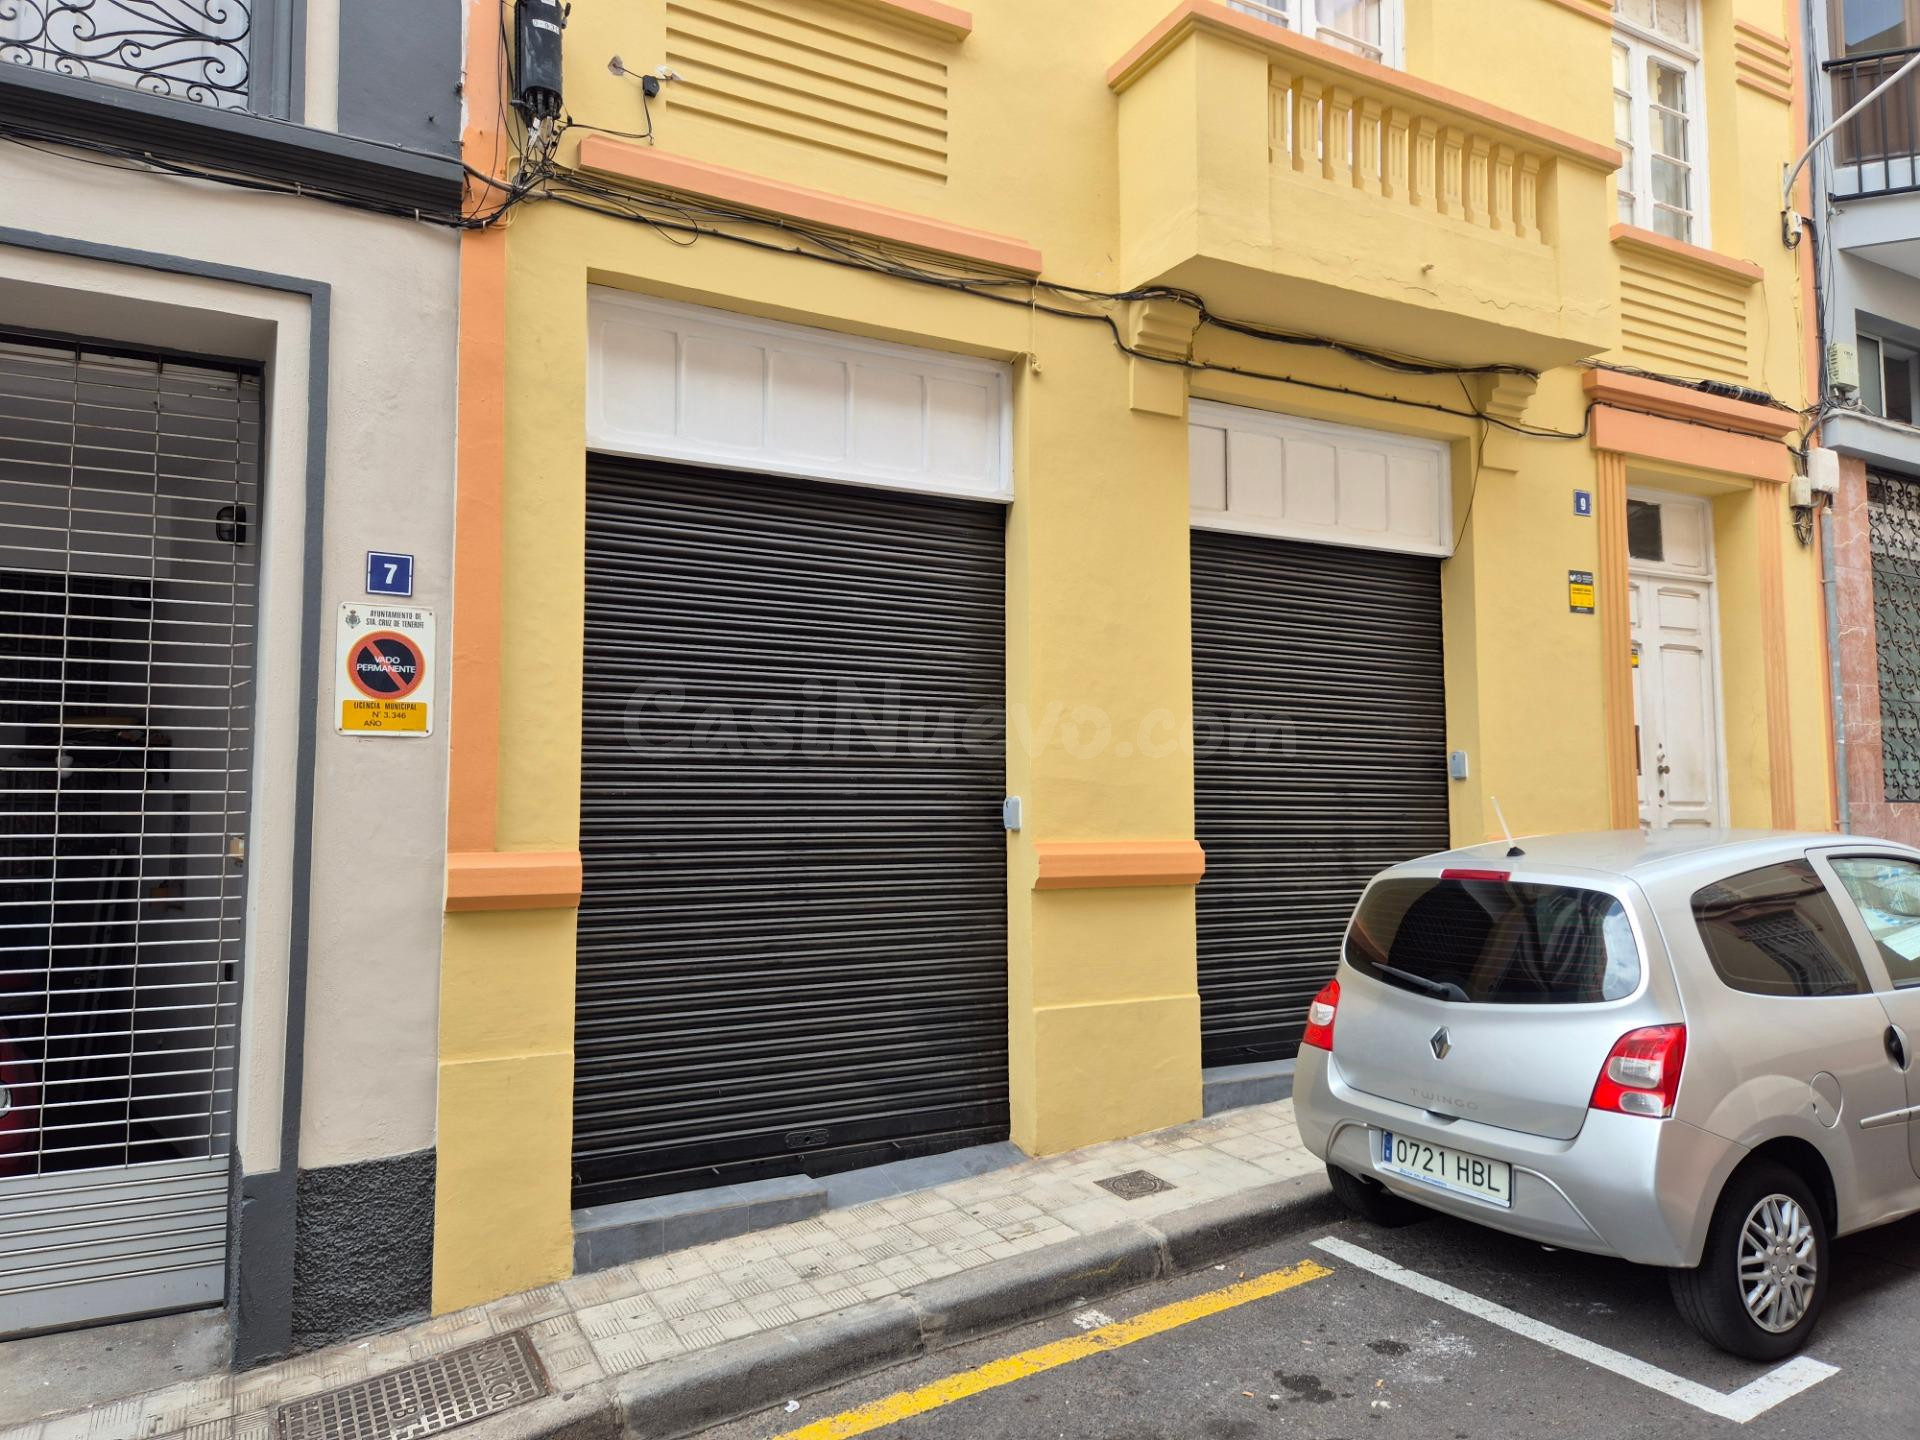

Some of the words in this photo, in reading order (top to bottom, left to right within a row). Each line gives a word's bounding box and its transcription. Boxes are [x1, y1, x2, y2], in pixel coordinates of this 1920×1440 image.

[1580, 498, 1586, 511] 9
[383, 563, 398, 585] 7
[370, 610, 412, 620] AYUNTAMIENTO
[378, 619, 392, 627] CRUZ
[394, 620, 400, 628] DE
[402, 621, 425, 629] TENERIFE
[374, 655, 401, 664] VADO
[356, 663, 416, 673] PERMANENTE
[353, 701, 381, 710] LICENCIA
[385, 702, 417, 711] MUNICIPAL
[384, 711, 407, 719] 3.346
[363, 719, 382, 727] AÑO
[1410, 1087, 1479, 1110] TWINGO
[1396, 1139, 1445, 1176] 0721
[1456, 1155, 1501, 1193] HBL
[476, 1348, 516, 1402] UNELCO
